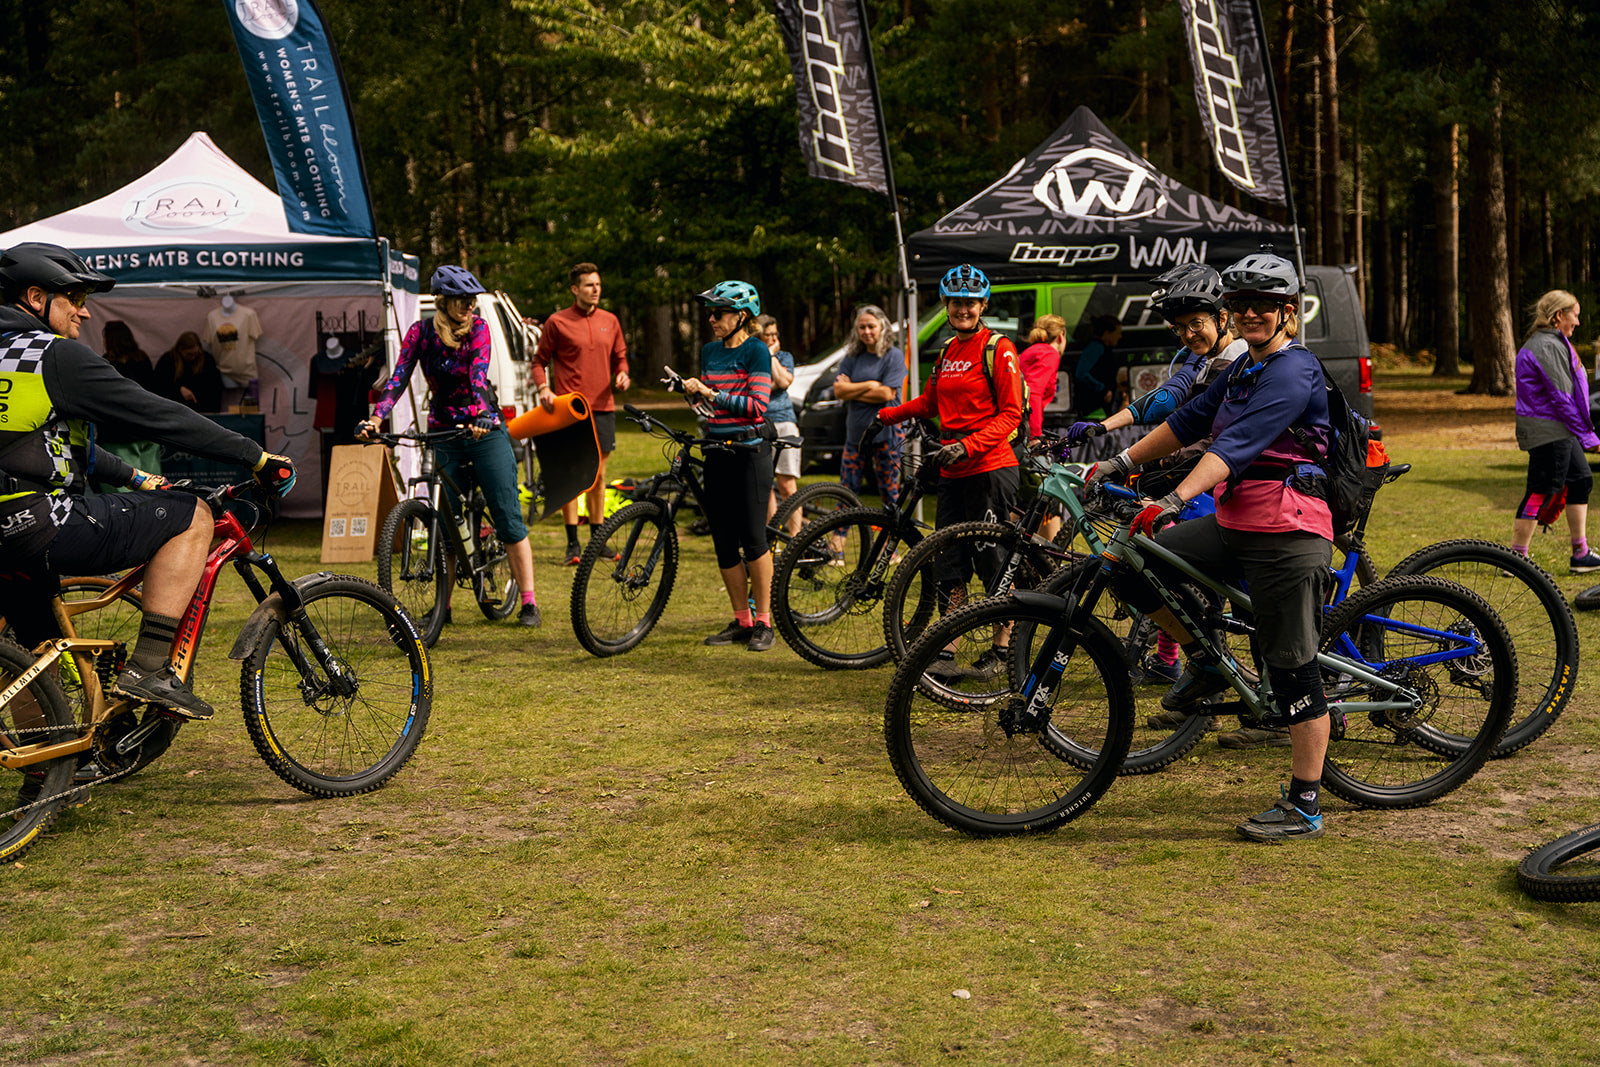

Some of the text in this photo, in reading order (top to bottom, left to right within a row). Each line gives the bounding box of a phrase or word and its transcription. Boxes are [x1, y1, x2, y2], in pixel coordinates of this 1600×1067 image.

[799, 0, 856, 175] hop
[276, 47, 331, 218] WOMEN'S MTB CLOTHING
[296, 41, 349, 215] TRAIL bloom
[82, 251, 304, 269] MEN'S MTB CLOTHING
[1009, 235, 1208, 269] hope WMN
[956, 530, 1003, 539] MAXXIS
[994, 565, 1018, 598] YRIK
[1053, 650, 1069, 666] 36
[2, 665, 41, 702] ALLMTN
[1026, 682, 1051, 717] FOX
[1545, 663, 1570, 714] MAXXIS
[1059, 791, 1092, 818] BUTCHER
